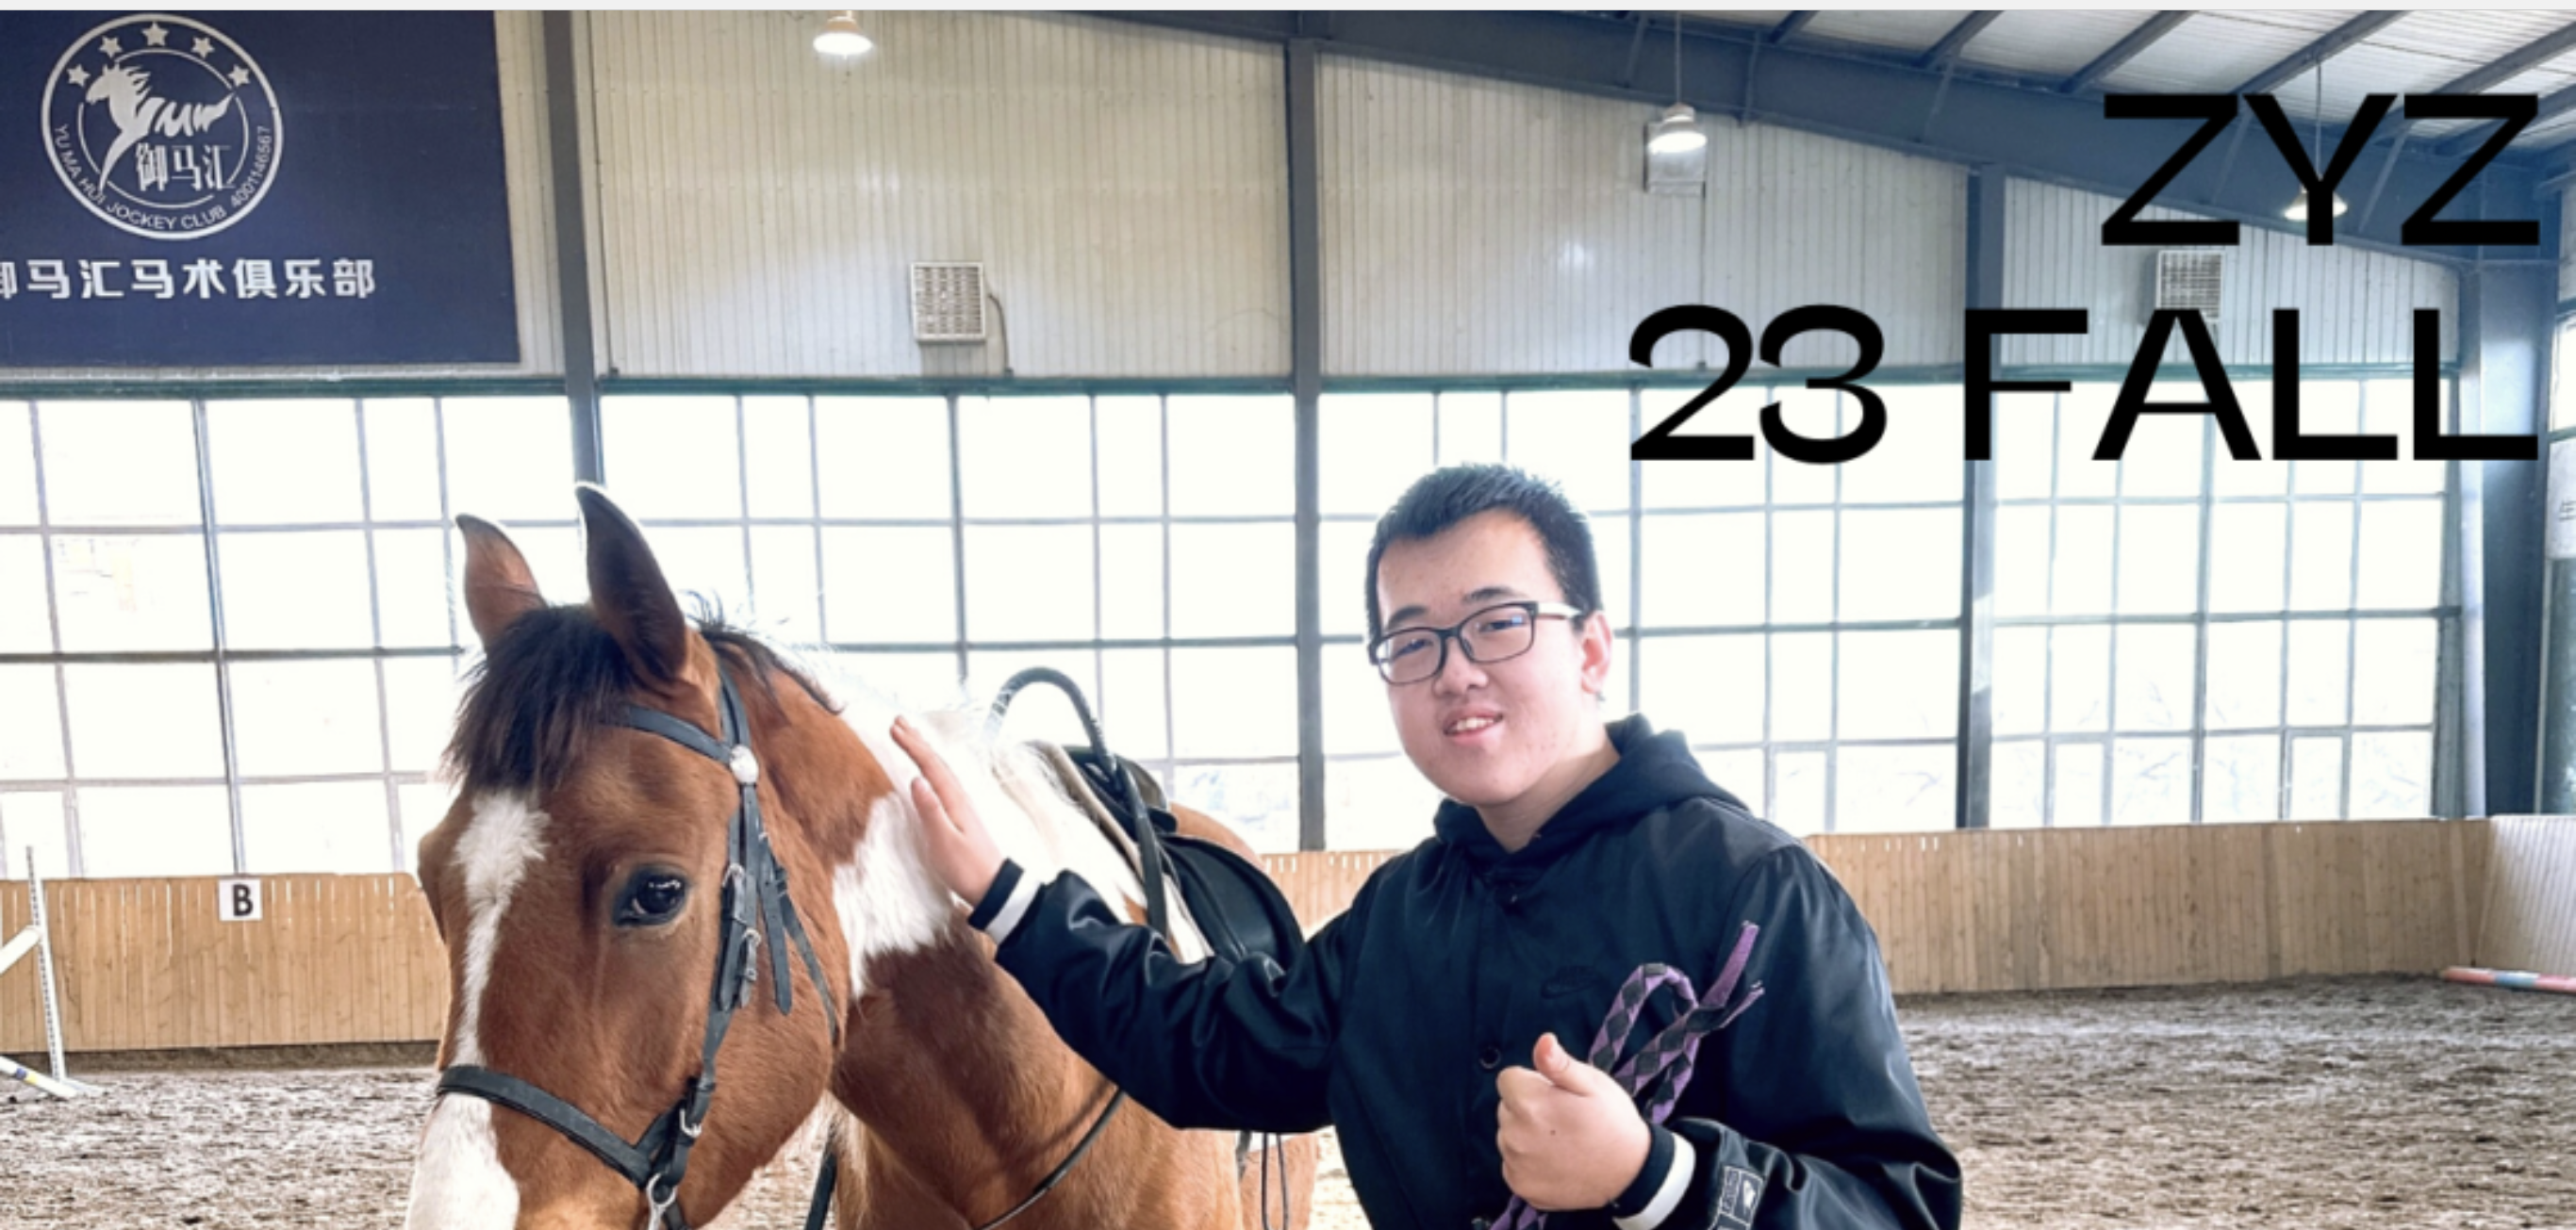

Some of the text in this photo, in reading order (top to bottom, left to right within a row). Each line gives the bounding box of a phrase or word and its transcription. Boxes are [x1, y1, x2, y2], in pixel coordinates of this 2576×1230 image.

[54, 123, 72, 149] YU
[59, 150, 83, 180] MA
[136, 142, 235, 191] 御马汇
[106, 201, 176, 230] JOCKEY
[181, 204, 227, 230] CLUB
[233, 883, 254, 917] B
